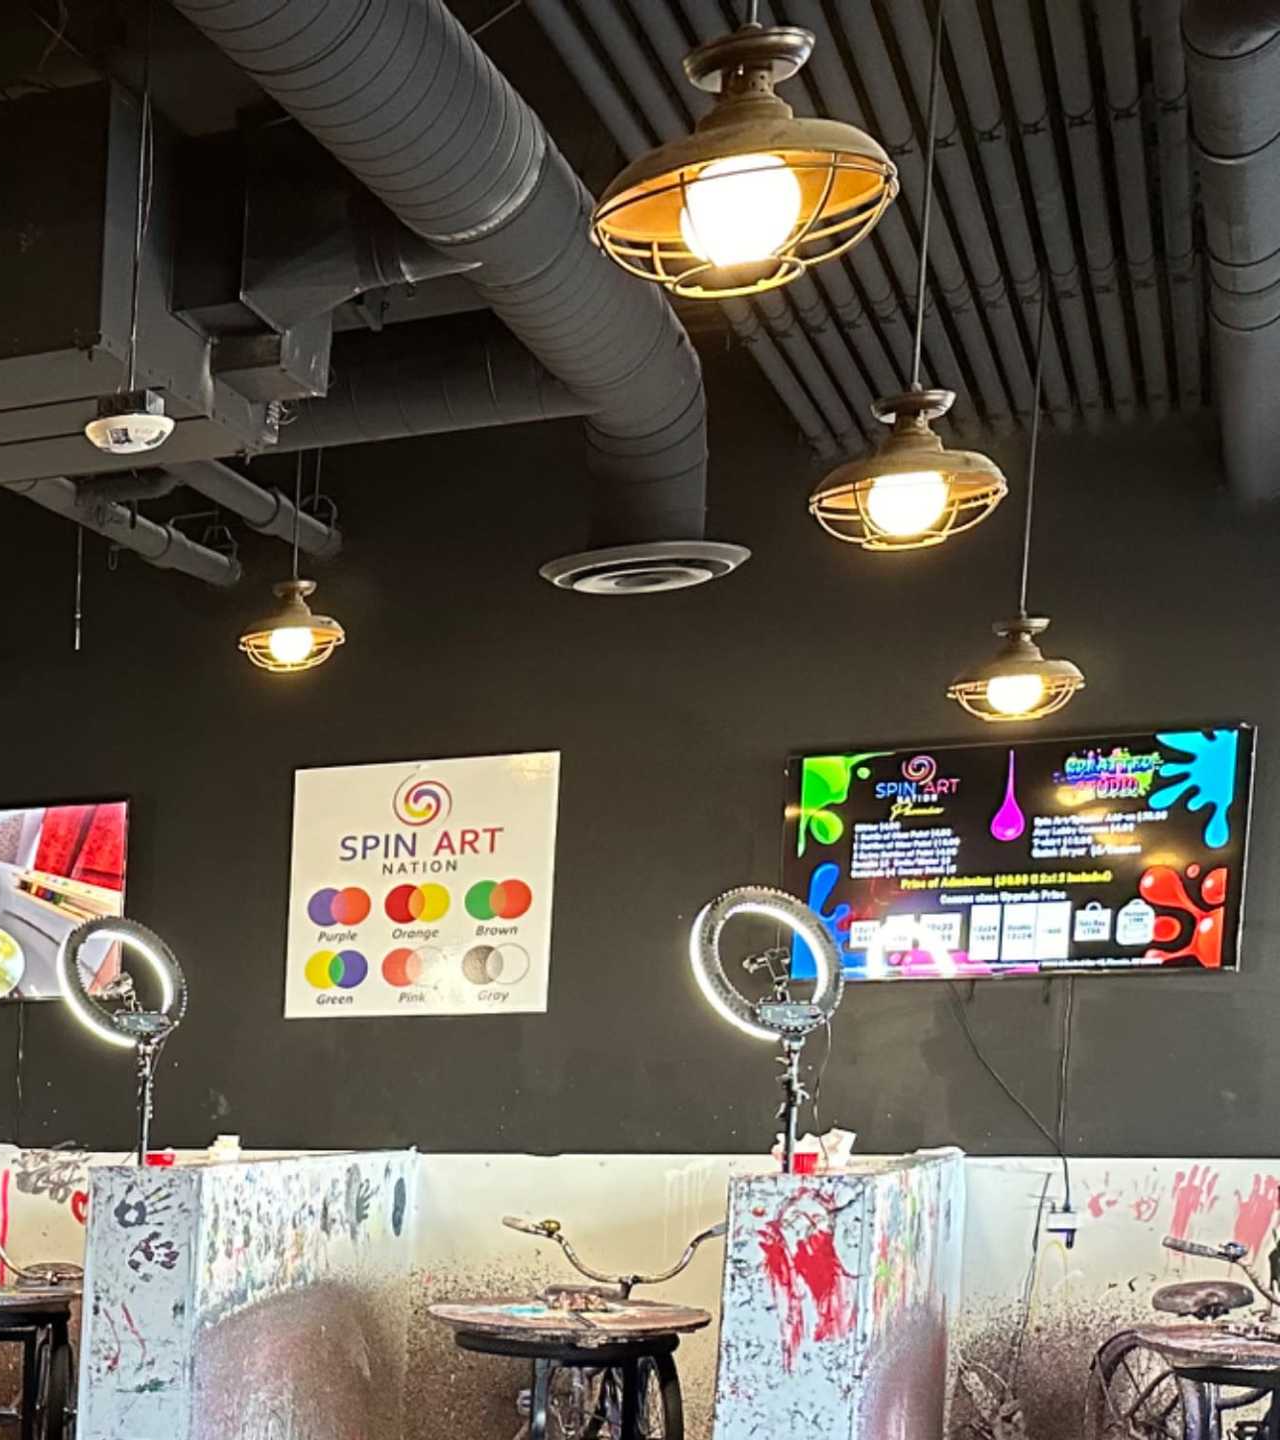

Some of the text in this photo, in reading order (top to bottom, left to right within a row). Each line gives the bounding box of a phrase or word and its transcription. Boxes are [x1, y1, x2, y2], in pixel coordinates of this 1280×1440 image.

[875, 779, 960, 799] SPIN ART
[340, 827, 504, 861] SPIN ART
[382, 860, 458, 876] NATION
[318, 931, 357, 942] Purple
[392, 928, 439, 940] Orange
[476, 925, 518, 937] Brown
[316, 993, 353, 1005] Green
[398, 992, 425, 1003] Pink
